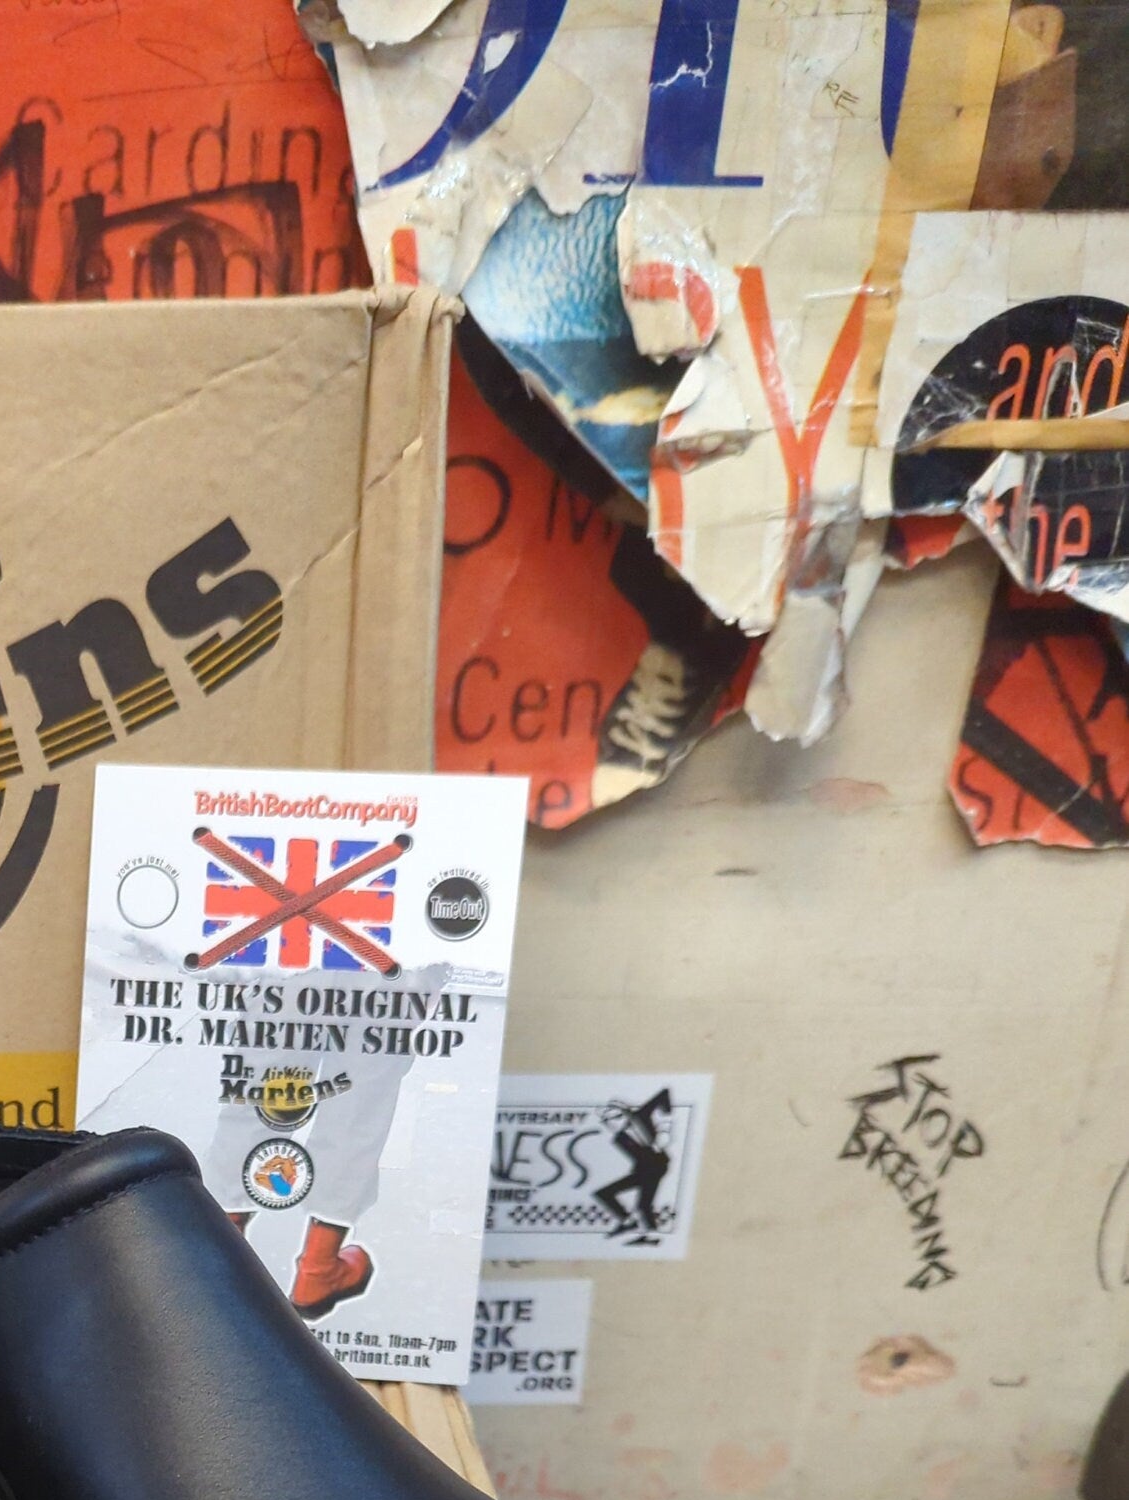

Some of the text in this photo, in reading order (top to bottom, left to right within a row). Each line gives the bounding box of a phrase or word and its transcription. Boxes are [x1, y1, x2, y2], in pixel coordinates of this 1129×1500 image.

[193, 790, 418, 829] BritishBootCompany
[109, 978, 478, 1024] THE UK'S ORIGINAL
[123, 1014, 465, 1060] DR. MARTEN SHOP
[220, 1053, 255, 1079] Dr.
[218, 1071, 353, 1106] Martens
[476, 1299, 533, 1322] ATE
[336, 1330, 350, 1345] to
[470, 1350, 578, 1373] SPECT
[515, 1376, 574, 1392] .ORG
